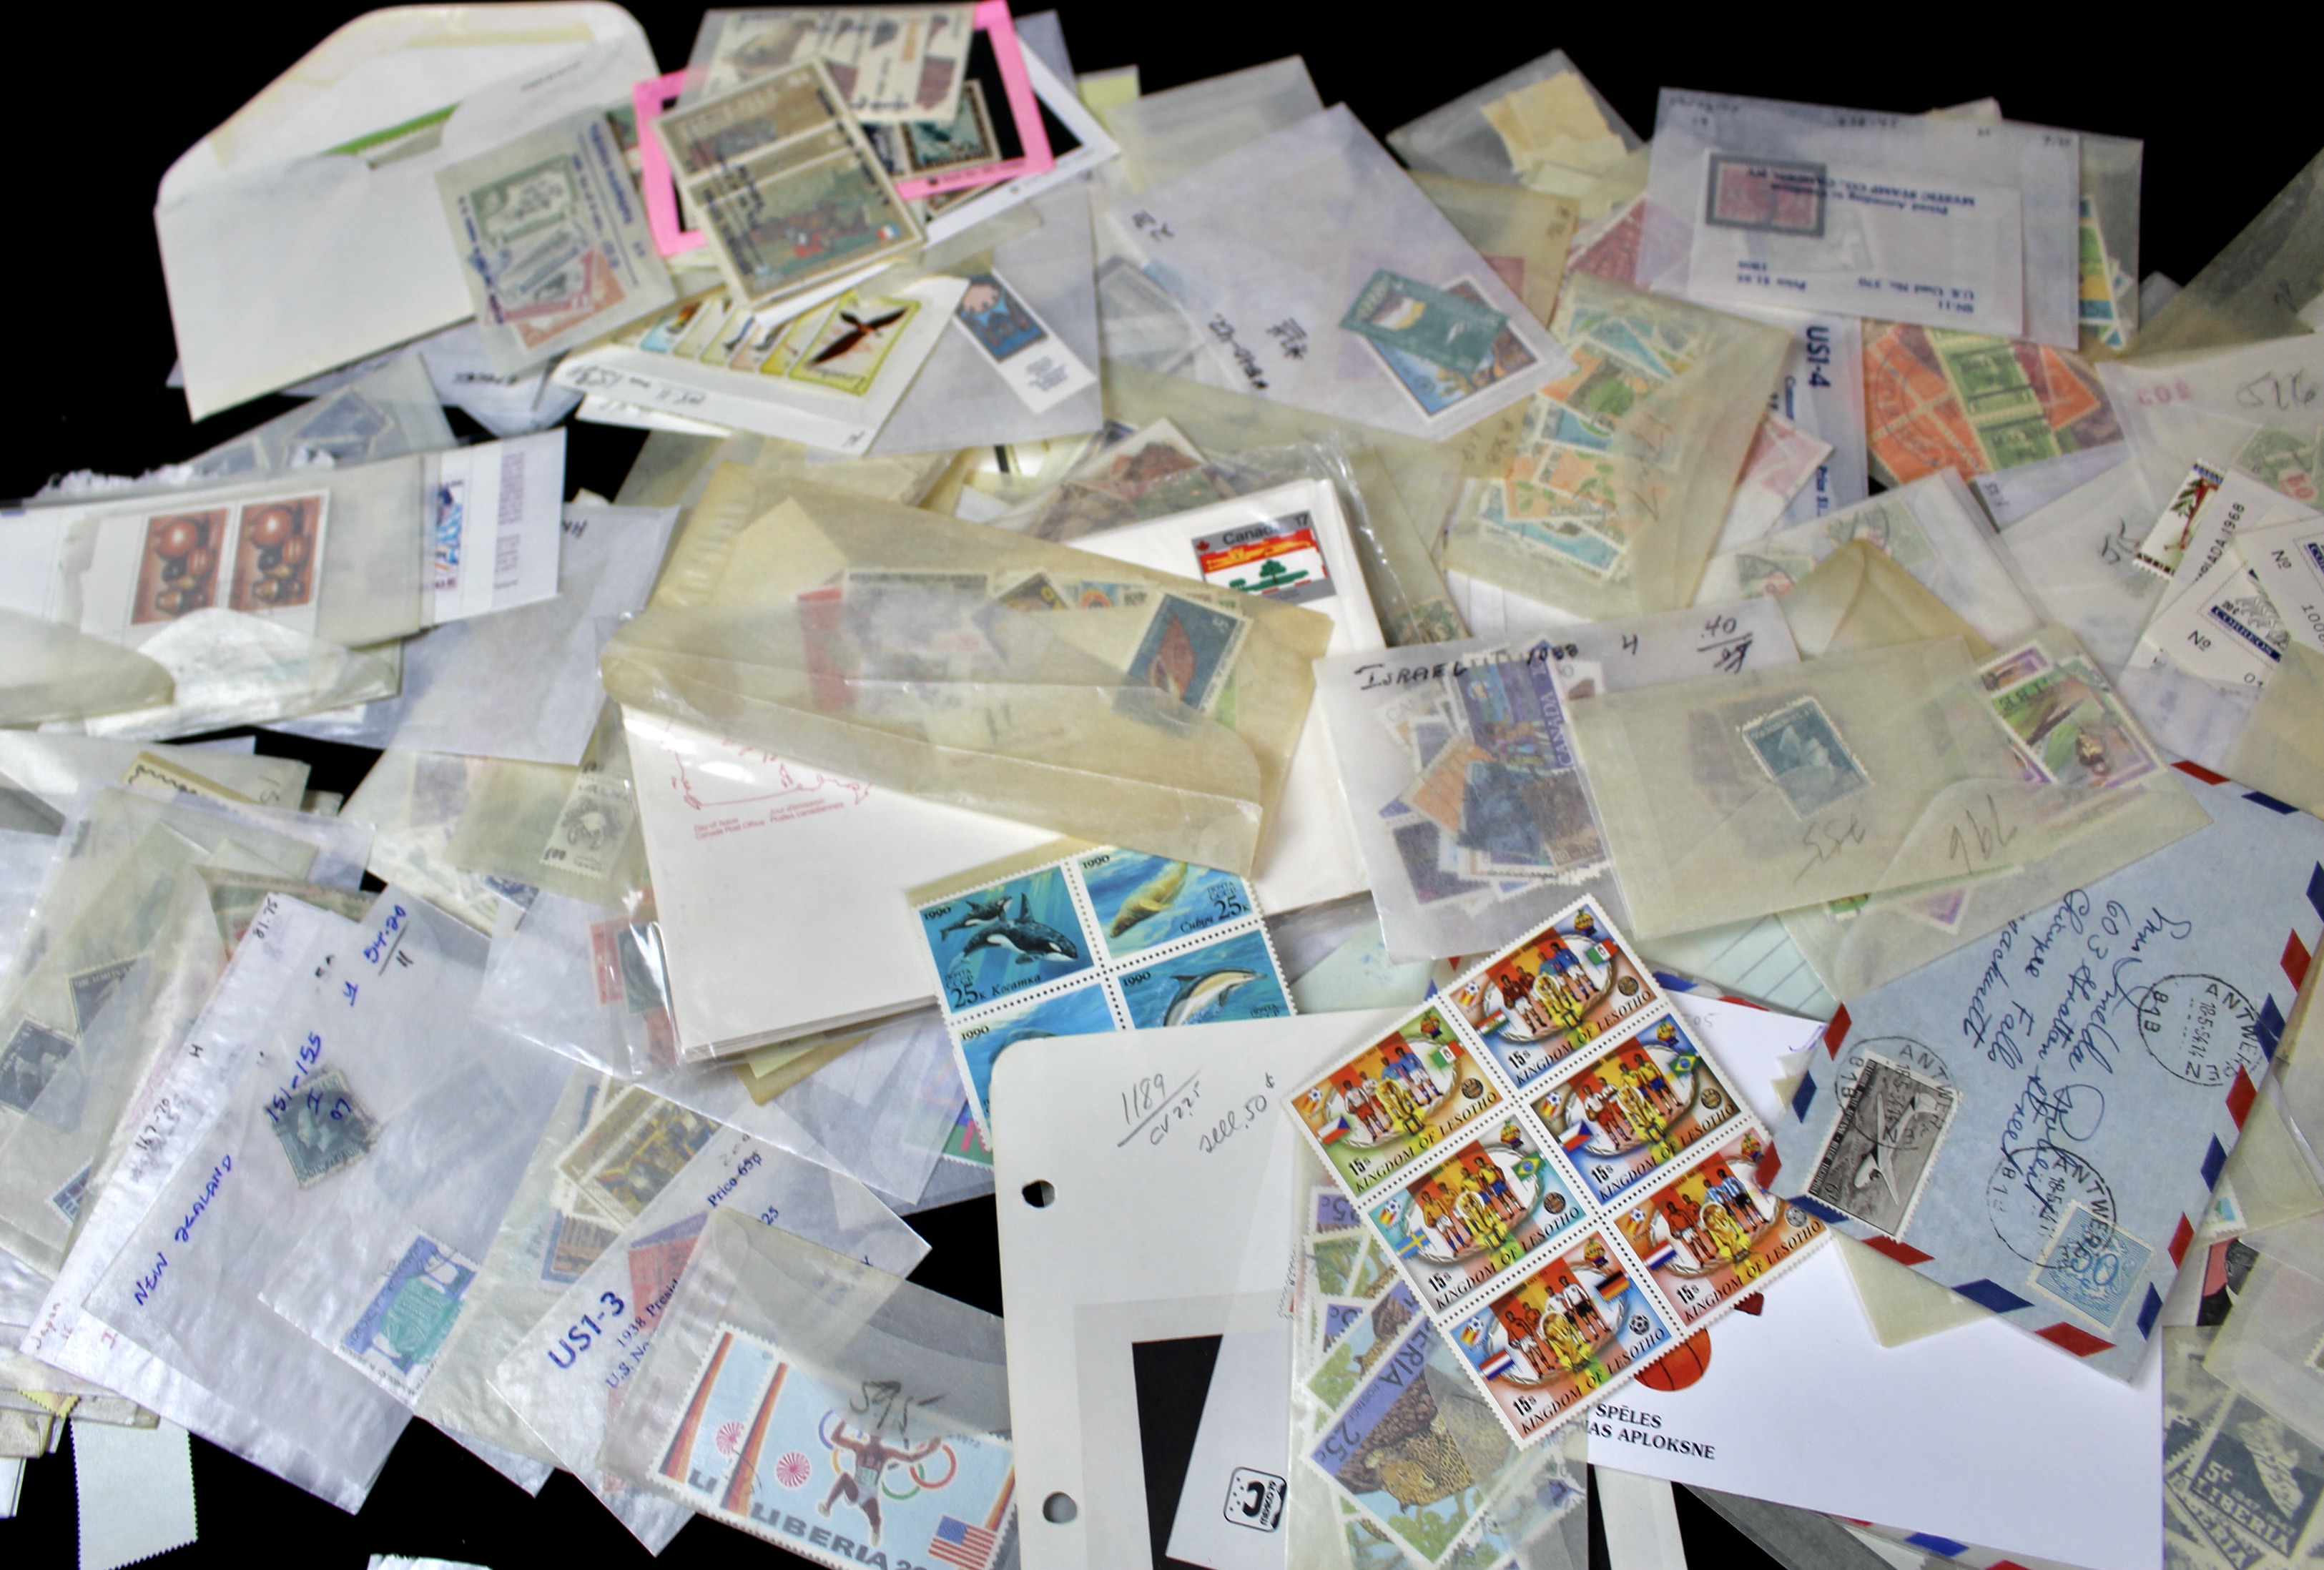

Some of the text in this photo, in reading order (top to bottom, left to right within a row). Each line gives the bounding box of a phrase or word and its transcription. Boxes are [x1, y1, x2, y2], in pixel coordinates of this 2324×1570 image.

[1806, 325, 1831, 388] US1-4
[1294, 513, 1309, 526] 17
[2221, 502, 2245, 535] 1968
[1081, 854, 1111, 870] 1990
[923, 906, 952, 921] 1990
[1122, 971, 1152, 988] 1990
[960, 1025, 990, 1042] 1990
[1515, 1042, 1573, 1086] KINGDOM
[1577, 1027, 1596, 1045] OF
[1595, 988, 1653, 1032] LESOTHO
[1354, 1147, 1416, 1193] KINGDOM
[1418, 1130, 1438, 1150] OF
[1439, 1092, 1499, 1135] LESOTHO
[1599, 1155, 1658, 1202] KINGDOM
[1661, 1141, 1680, 1159] OF
[1680, 1101, 1736, 1147] LESOTHO
[133, 1251, 169, 1306] NEW
[1436, 1205, 1580, 1310] KINGDOM OF LESOTHO
[1685, 1219, 1821, 1322] KINGDOM OF LESOTHO
[547, 1290, 626, 1371] US1-3
[616, 1315, 646, 1349] 1938
[1521, 1327, 1665, 1434] KINGDOM OF LESOTHO
[1595, 1402, 1663, 1429] SPĒLES
[1618, 1427, 1715, 1460] APLOKSNE
[687, 1468, 718, 1496] LI
[750, 1501, 890, 1570] LIBERIA
[2194, 1478, 2290, 1556] LIBERIA
